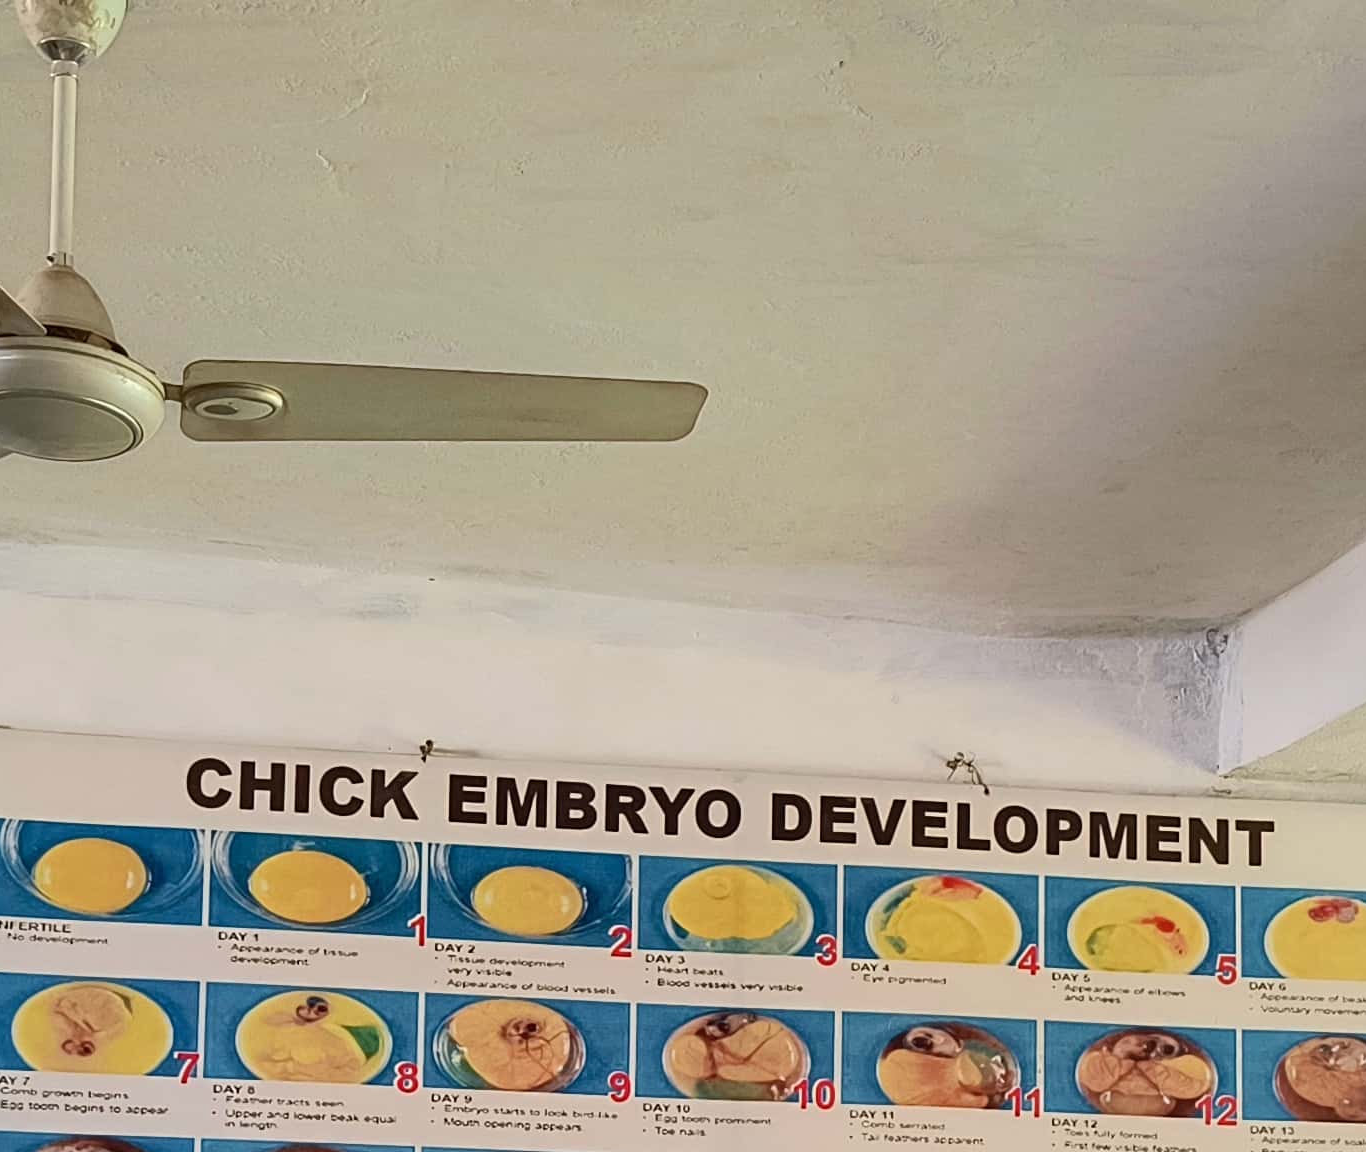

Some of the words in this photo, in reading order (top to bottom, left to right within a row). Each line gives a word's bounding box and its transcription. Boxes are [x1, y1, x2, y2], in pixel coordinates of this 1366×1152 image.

[186, 757, 420, 821] CHICK
[448, 773, 742, 840] EMBRYO
[770, 791, 1275, 867] DEVELOPMENT
[218, 932, 247, 942] DAY
[253, 933, 259, 942] 1
[408, 915, 426, 947] 1
[608, 926, 633, 957] 2
[435, 942, 463, 953] DAY
[467, 944, 476, 954] 2
[645, 953, 673, 964] DAY
[677, 955, 685, 965] 3
[815, 935, 837, 966] 3
[1017, 944, 1040, 976] 4
[1216, 954, 1237, 985] 5
[22, 1076, 30, 1085] 7
[173, 1054, 200, 1085] 7
[395, 1062, 419, 1094] 8
[607, 1072, 631, 1103] 9
[792, 1079, 836, 1110] 10
[1005, 1089, 1040, 1117] 11
[643, 1102, 671, 1113] DAY
[677, 1104, 690, 1113] 10
[850, 1110, 877, 1119] DAY
[882, 1111, 894, 1120] 11
[1052, 1117, 1079, 1127] DAY
[1084, 1119, 1097, 1128] 12
[1195, 1095, 1237, 1127] 12
[1251, 1126, 1275, 1134] DAY
[1282, 1127, 1294, 1135] 13
